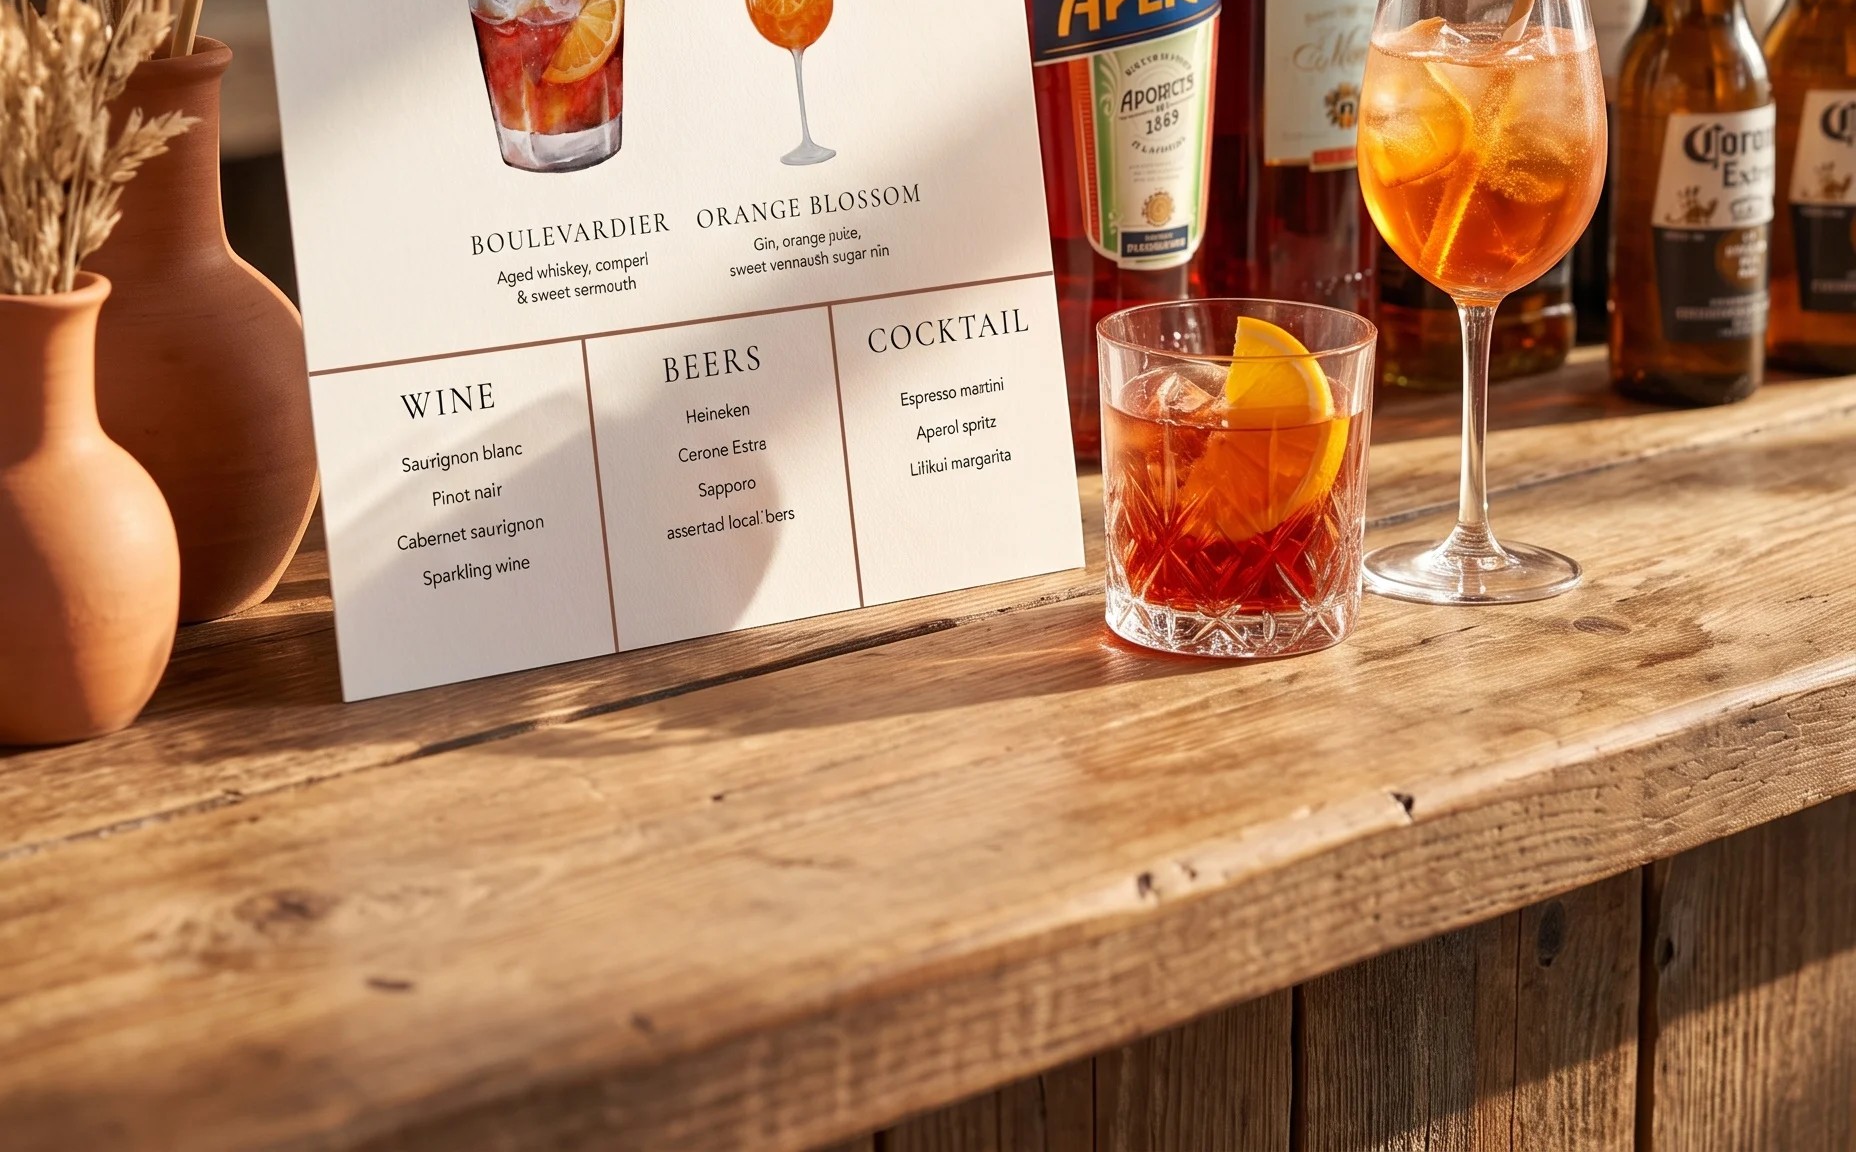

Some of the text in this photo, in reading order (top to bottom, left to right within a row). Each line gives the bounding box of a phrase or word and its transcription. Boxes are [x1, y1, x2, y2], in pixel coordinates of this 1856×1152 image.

[1146, 109, 1180, 135] 1869
[697, 183, 922, 229] ORANGE BLOSSOM
[470, 212, 671, 256] BOULEVARDIER
[753, 236, 779, 251] Gin,
[782, 232, 826, 249] orange
[497, 266, 534, 288] Aged
[537, 260, 592, 280] whiskey,
[729, 260, 767, 277] sweet
[832, 248, 867, 265] sugar
[517, 275, 637, 305] & sweet sermouth
[867, 308, 1029, 354] COCKTAIL
[662, 344, 762, 384] BEERS
[400, 382, 495, 421] WINE
[900, 388, 957, 410] Espresso
[685, 401, 751, 424] Heineken
[962, 415, 997, 437] spritz
[482, 443, 523, 461] blanc
[678, 445, 729, 463] Cerone
[951, 448, 1012, 470] margarita
[432, 488, 471, 507] Pinot
[698, 478, 757, 500] Sapporo
[397, 527, 468, 551] Cabernet
[667, 515, 725, 540] assertad
[423, 556, 531, 590] Sparkling wine
